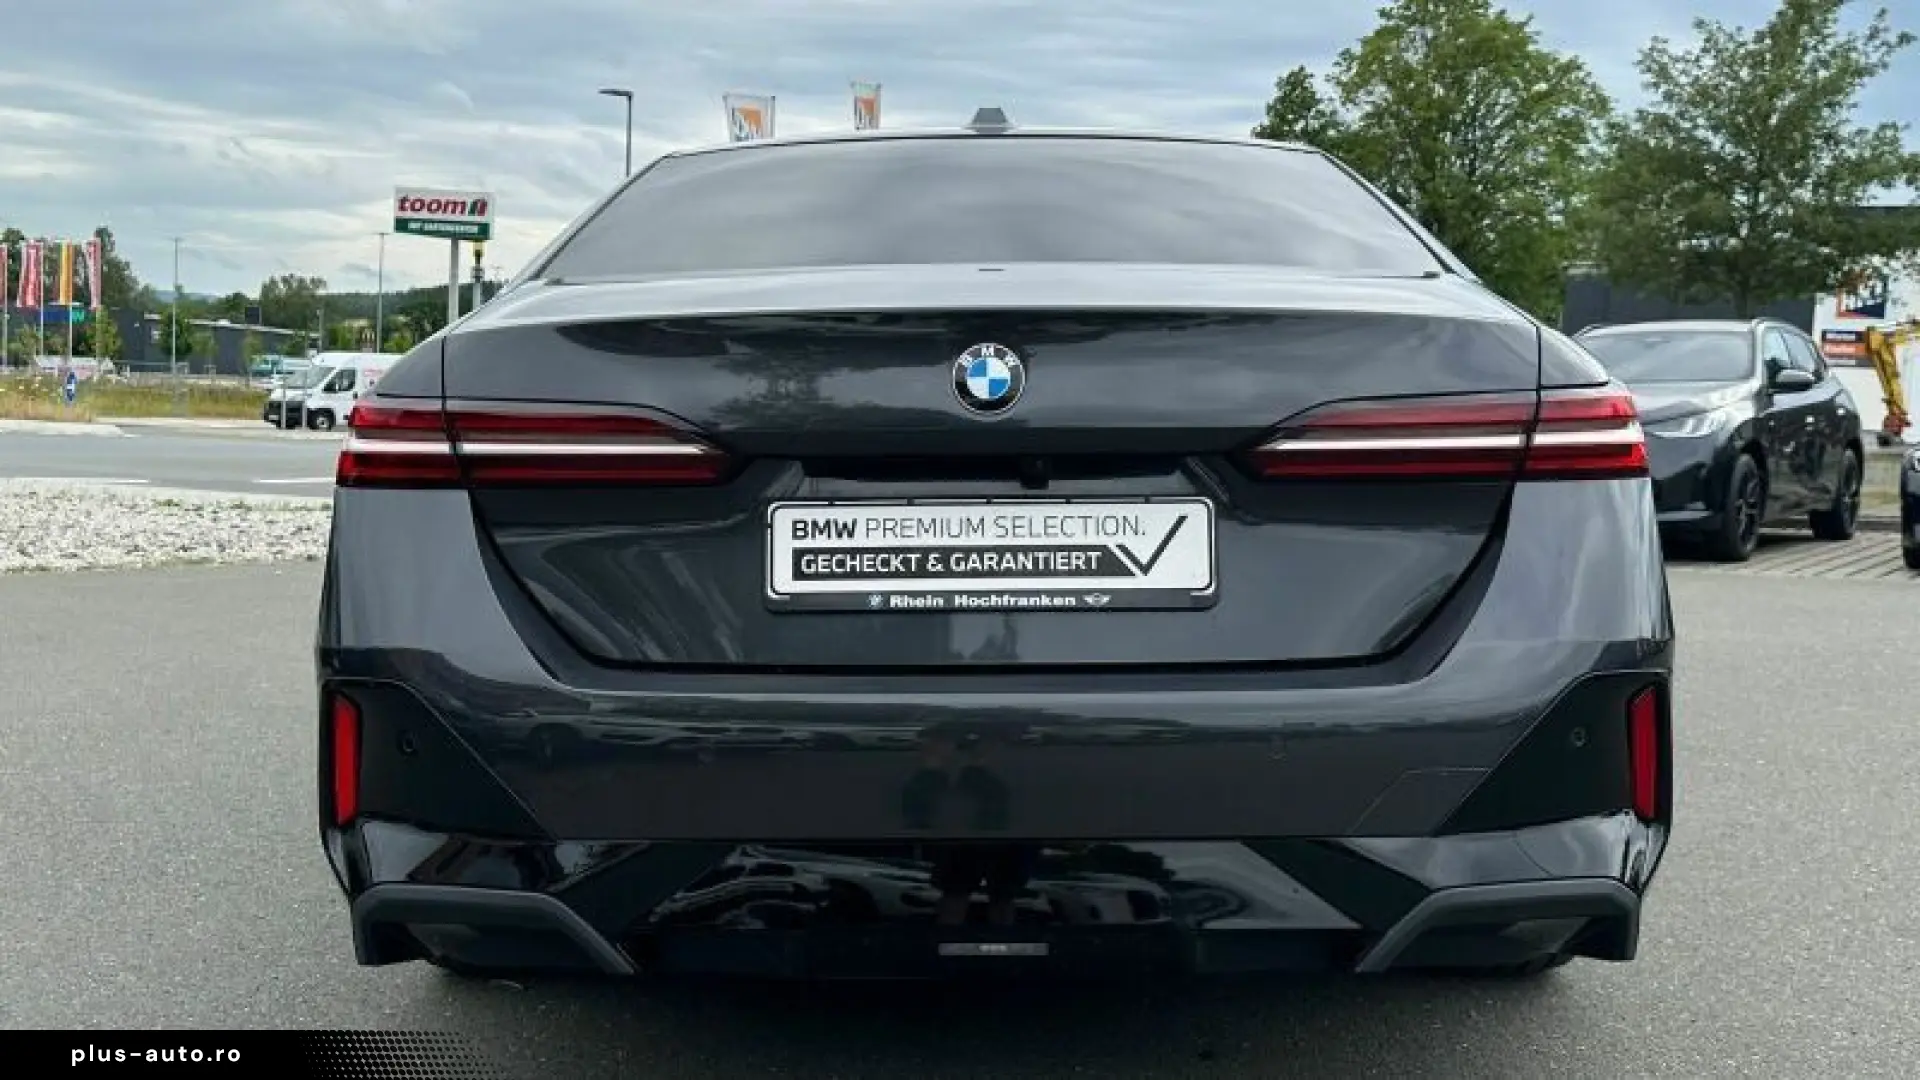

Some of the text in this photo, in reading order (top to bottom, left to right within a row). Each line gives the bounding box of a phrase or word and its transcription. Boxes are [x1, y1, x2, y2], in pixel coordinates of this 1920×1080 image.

[398, 195, 467, 215] toom
[958, 344, 1021, 368] BMW
[791, 515, 1146, 540] BMW PREMIUM SELECTION.
[801, 551, 1102, 574] GECHECKT & GARANTIERT
[889, 594, 1076, 608] Rhein Hochfranken
